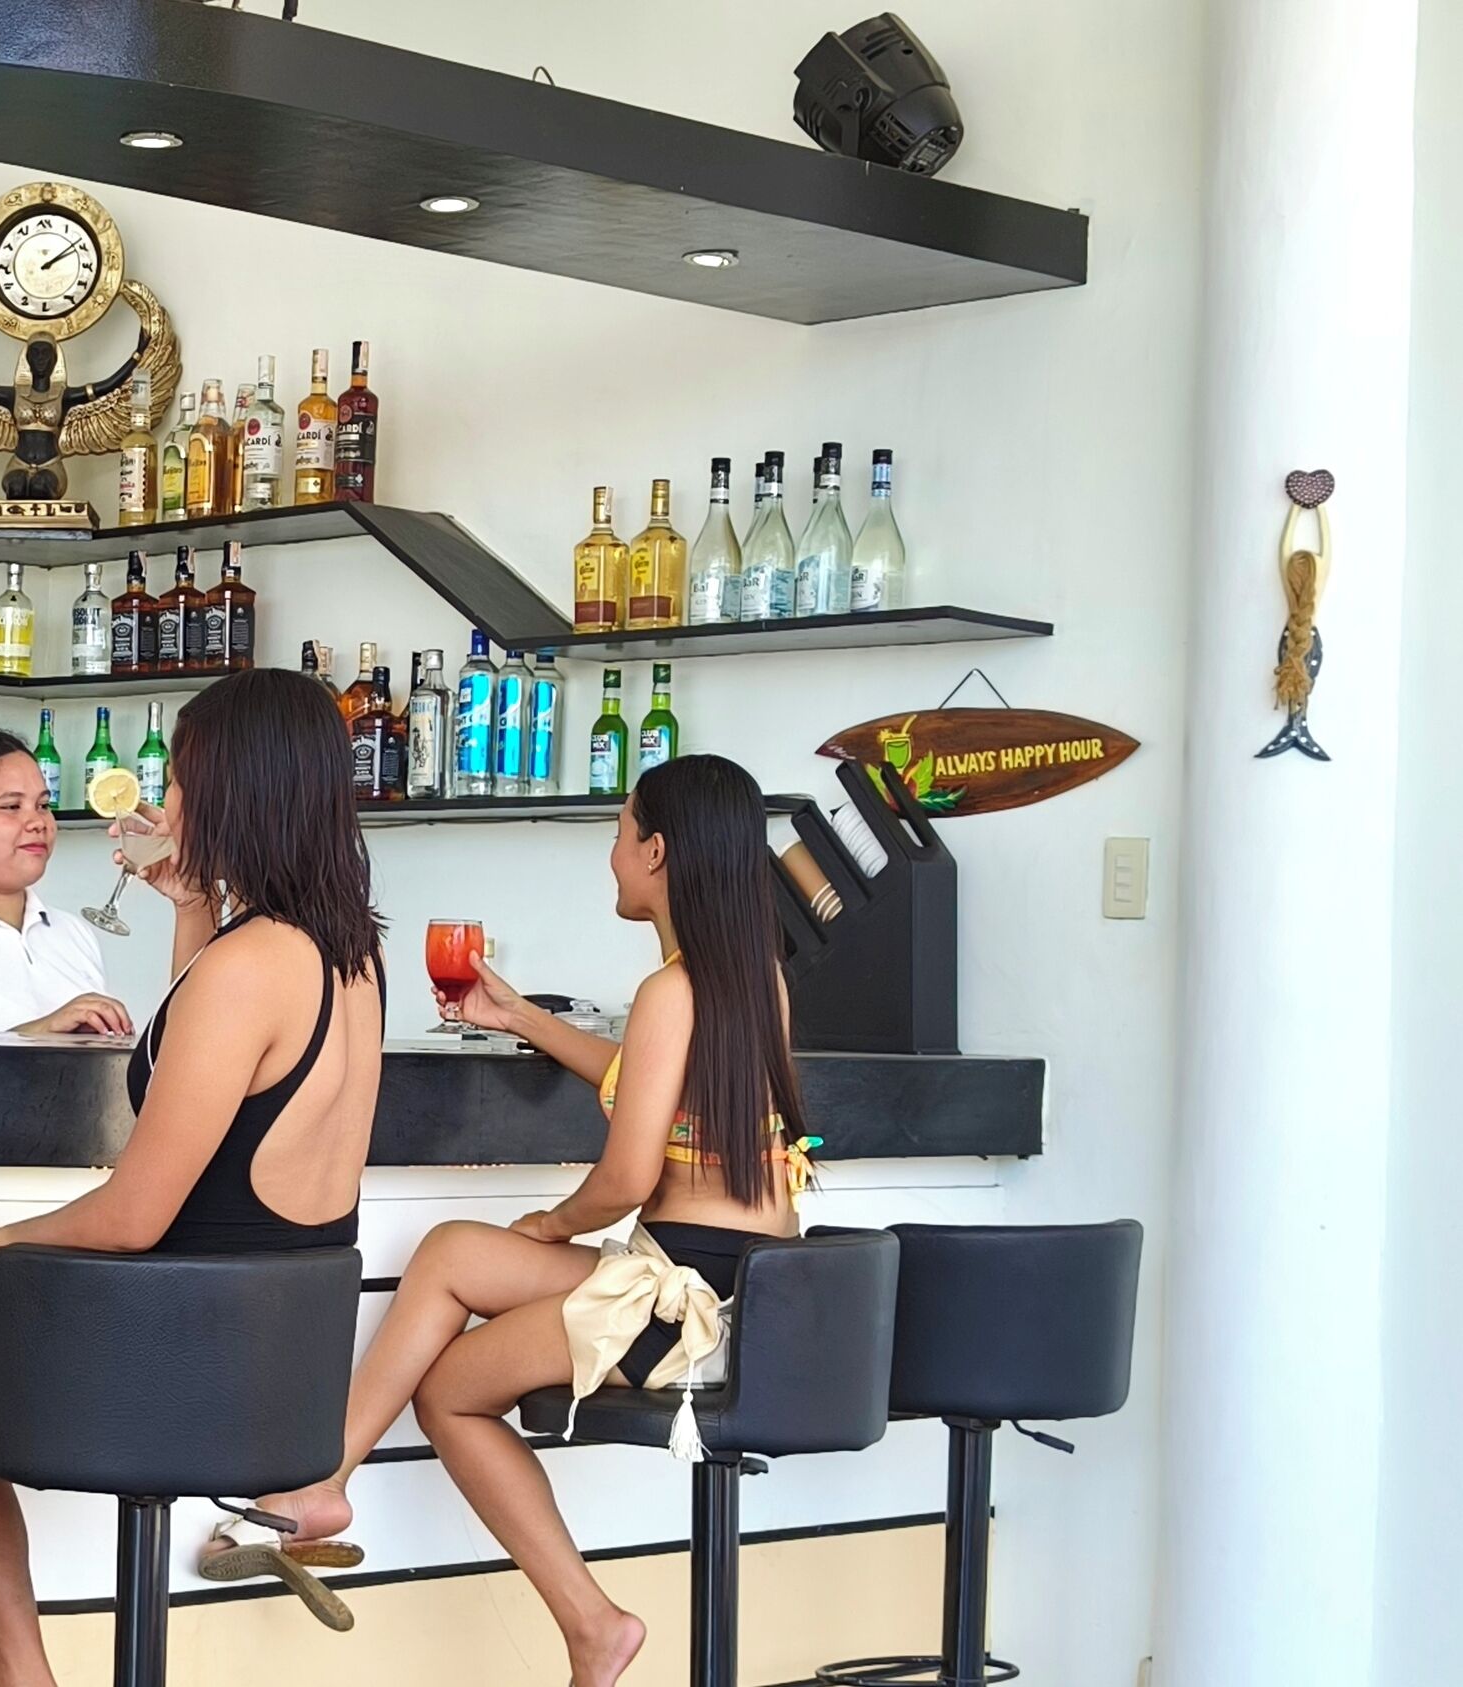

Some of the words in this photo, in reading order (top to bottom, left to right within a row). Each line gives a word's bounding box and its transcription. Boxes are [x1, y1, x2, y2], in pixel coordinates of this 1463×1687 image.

[245, 435, 271, 446] CARDÍ
[298, 430, 321, 441] CARDÍ
[935, 751, 996, 776] ALWAYS
[1001, 742, 1057, 770] HAPPY
[1059, 738, 1104, 763] HOUR
